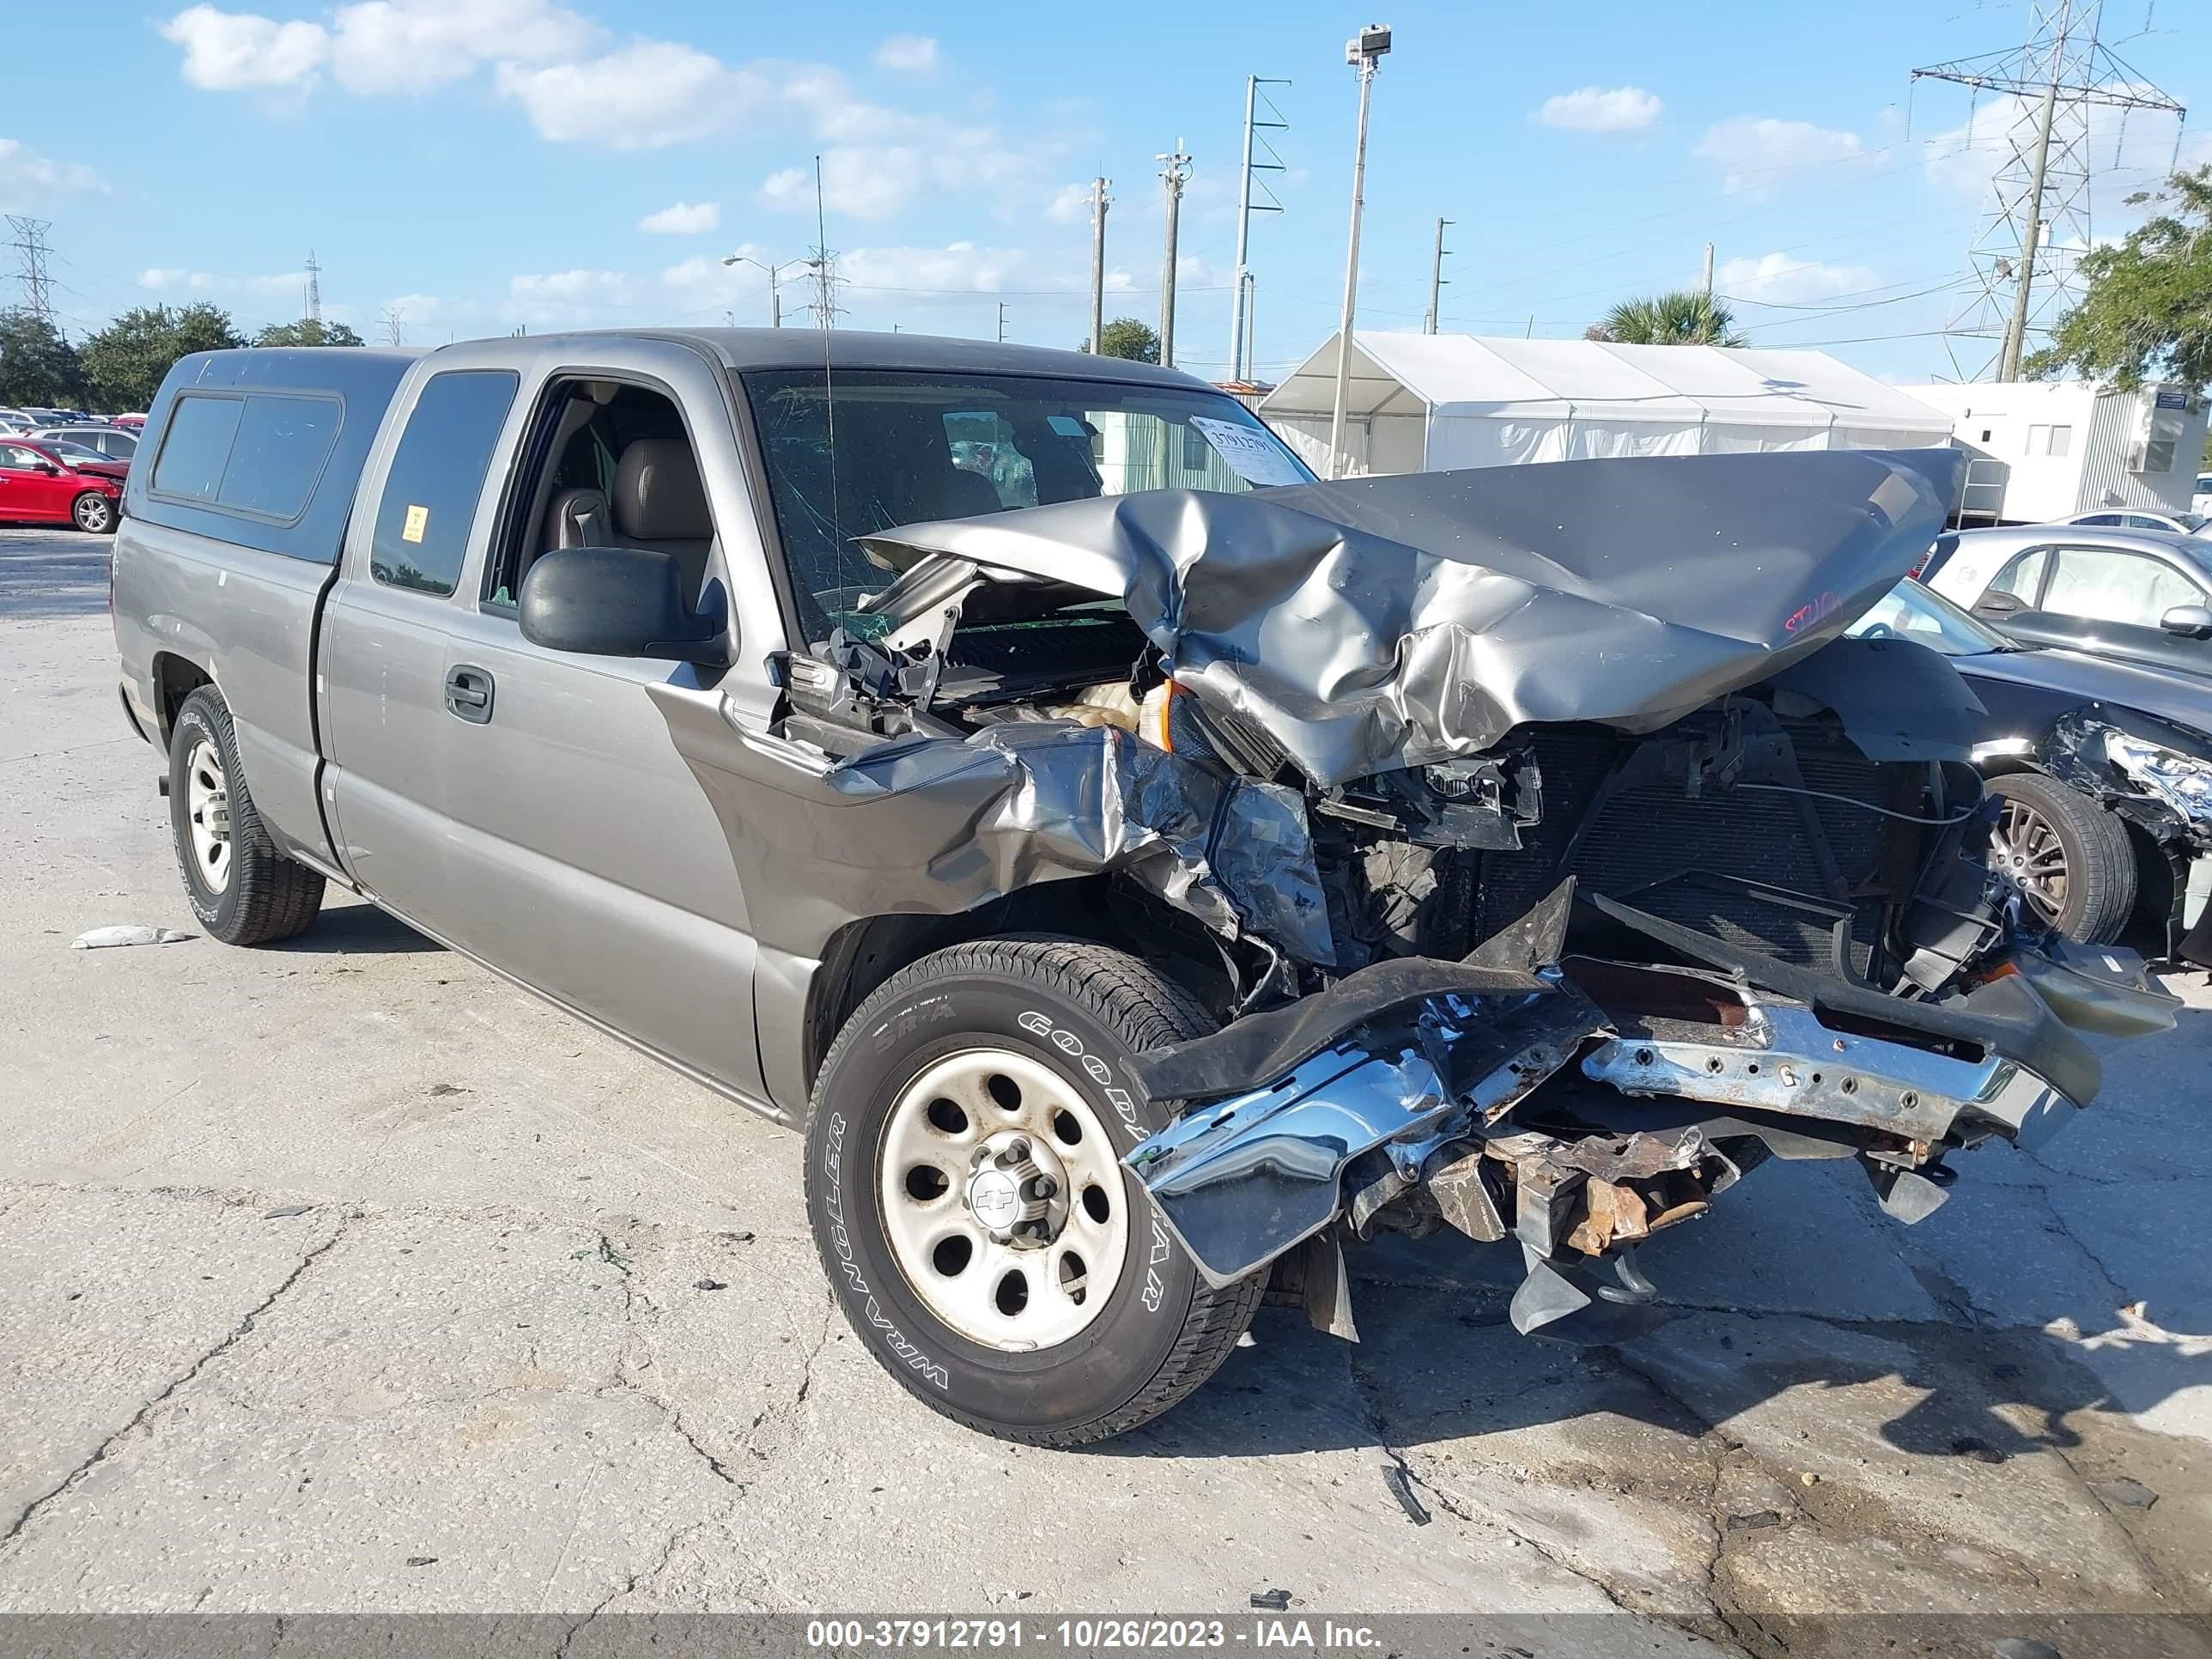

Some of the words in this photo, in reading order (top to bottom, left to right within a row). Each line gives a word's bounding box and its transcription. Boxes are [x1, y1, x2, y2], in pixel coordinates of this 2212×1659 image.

[1211, 432, 1274, 453] 37912791
[823, 1111, 950, 1392] WRANGLER
[1018, 1011, 1171, 1313] GOODAR
